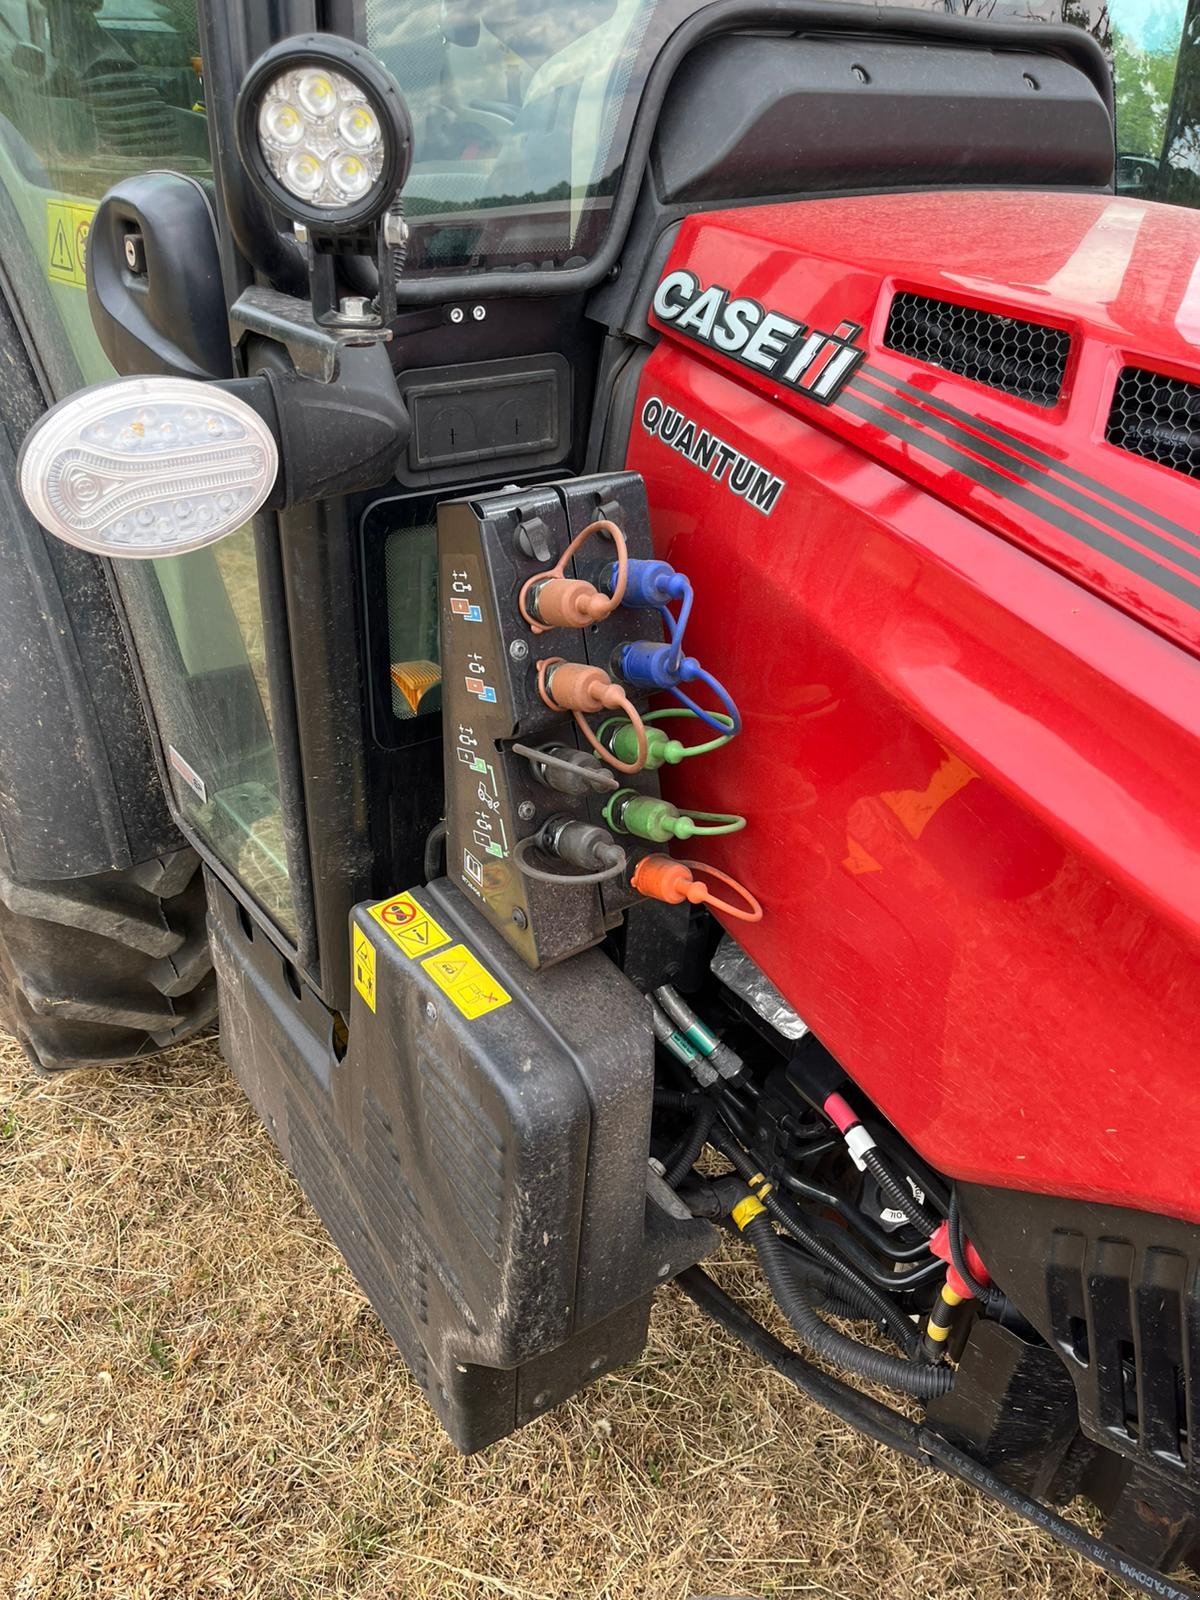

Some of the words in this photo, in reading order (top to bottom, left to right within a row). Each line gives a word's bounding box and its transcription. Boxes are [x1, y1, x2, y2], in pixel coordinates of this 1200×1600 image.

[653, 271, 801, 370] CASE
[642, 397, 786, 516] QUANTUM
[890, 1211, 903, 1220] OIL
[1117, 1558, 1180, 1600] ALFAGOMMA
